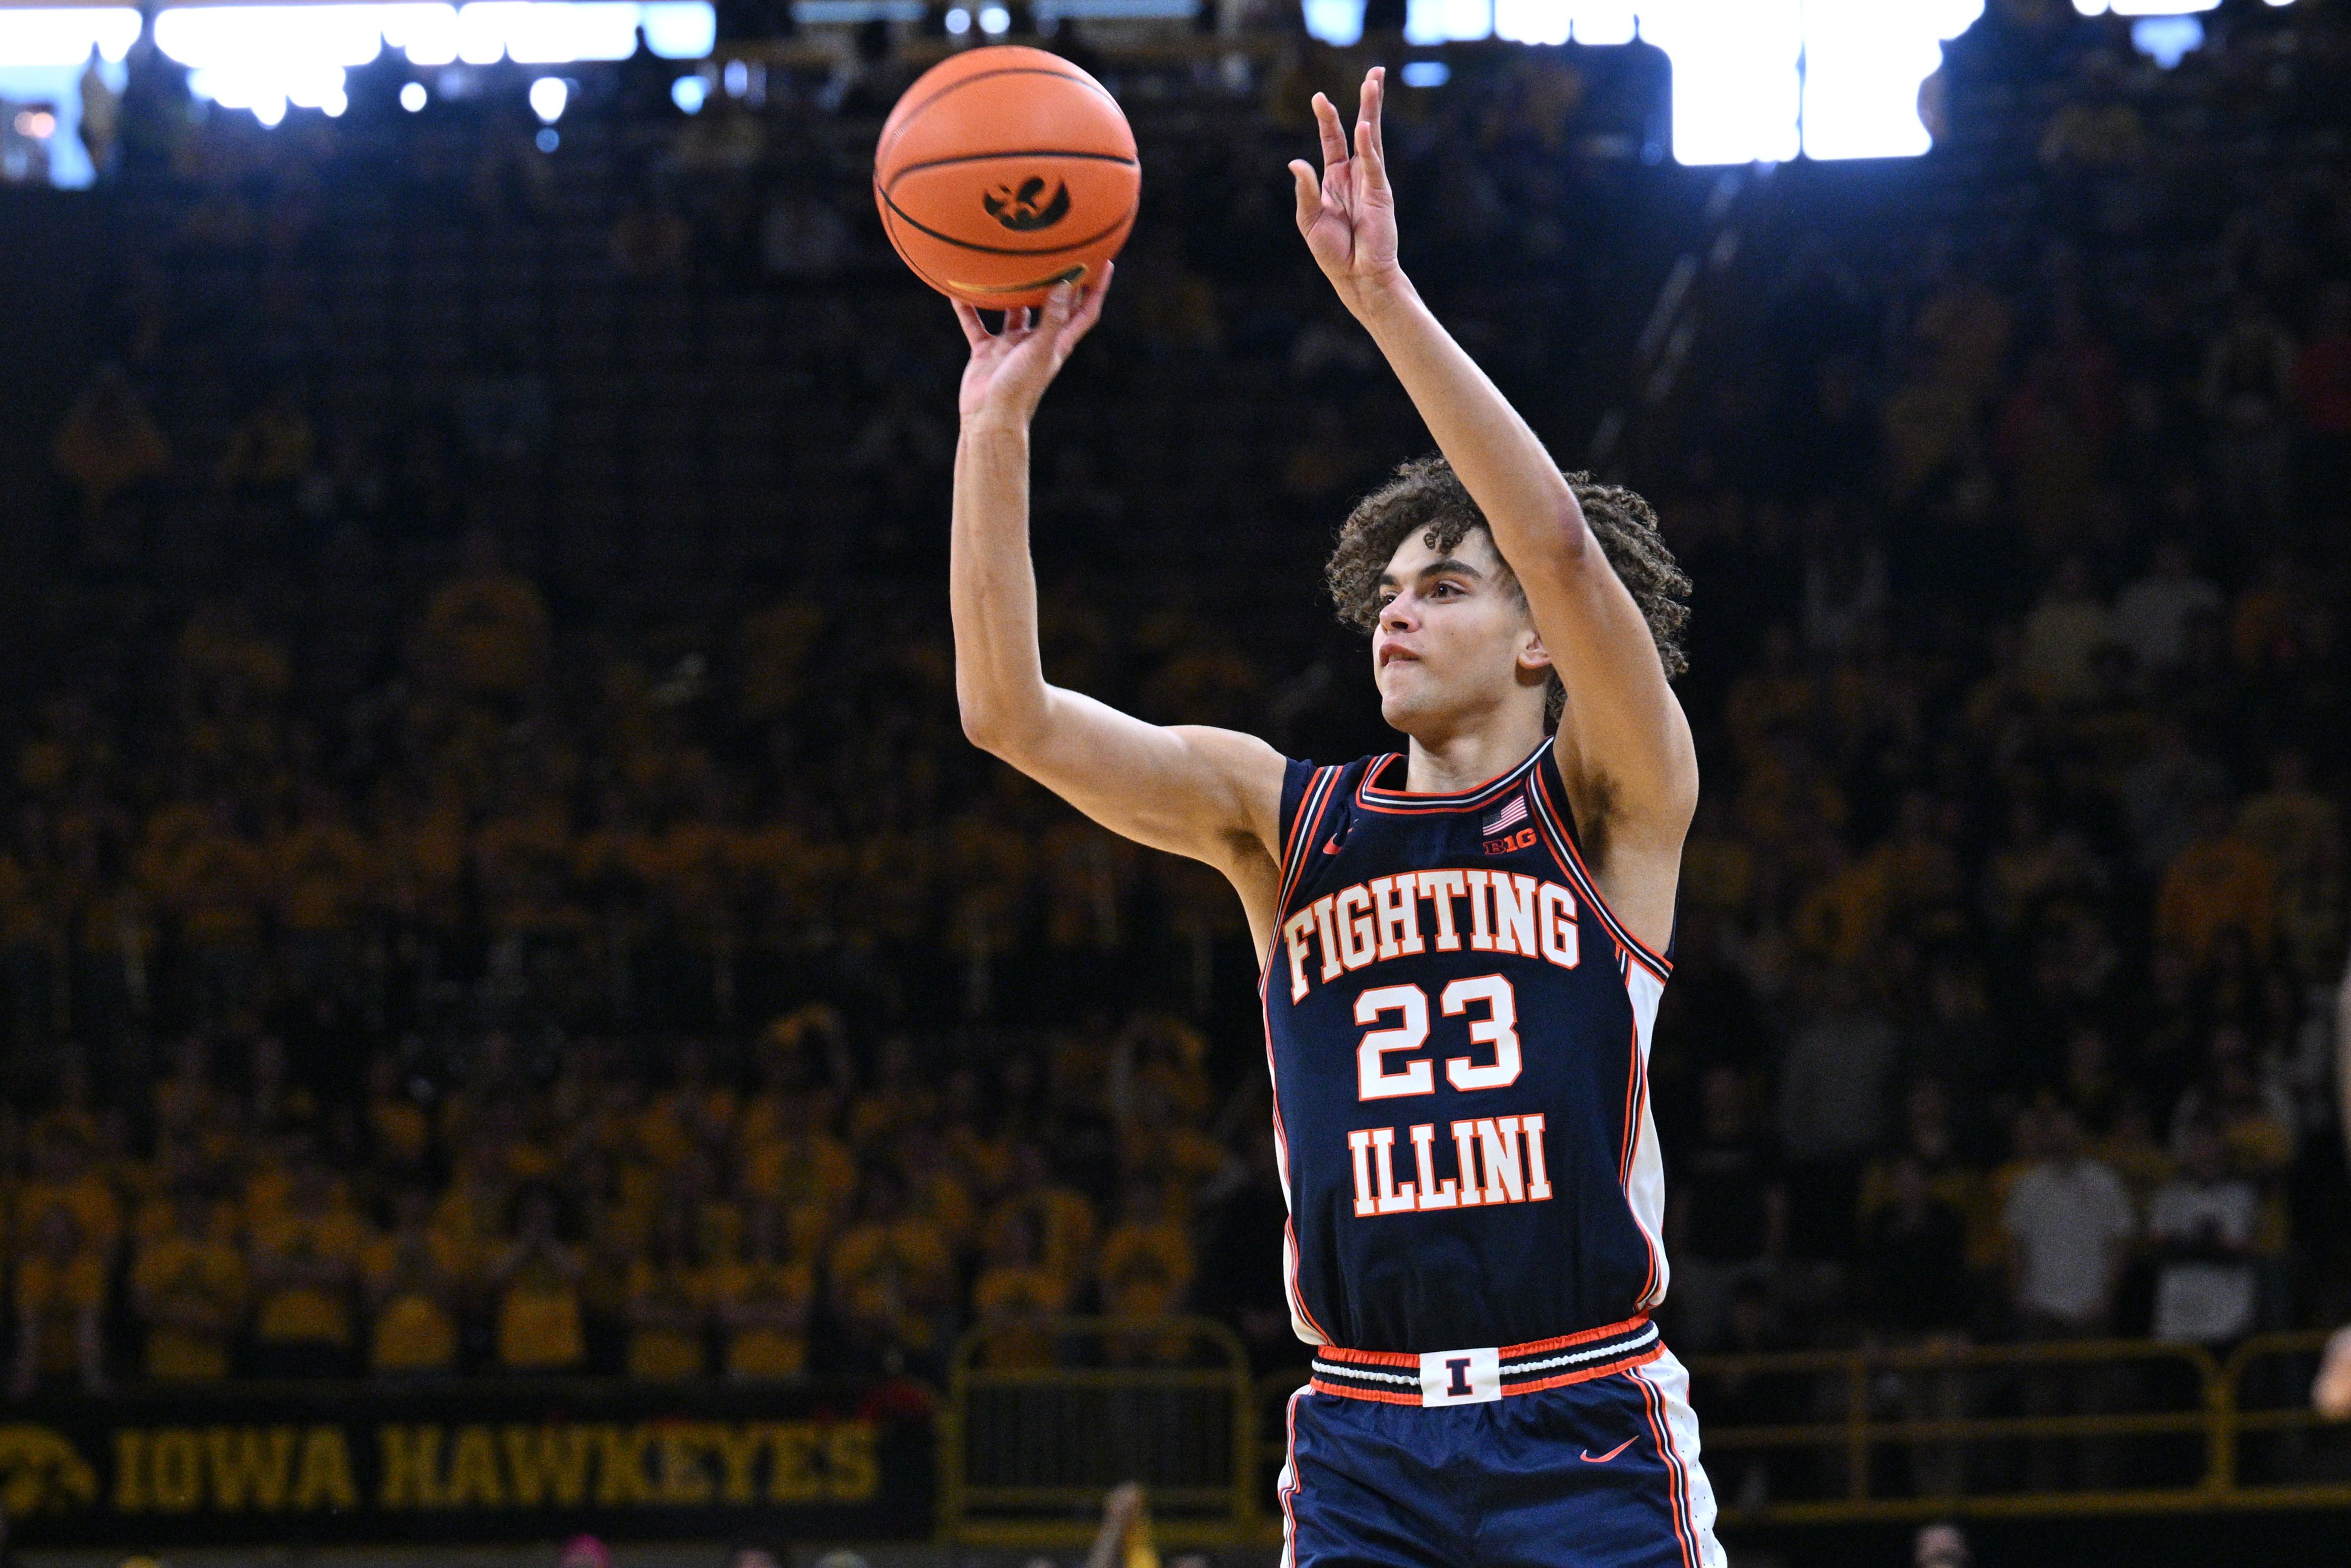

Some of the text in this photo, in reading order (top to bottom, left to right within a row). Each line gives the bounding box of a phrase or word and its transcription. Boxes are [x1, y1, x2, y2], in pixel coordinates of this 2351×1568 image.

[1283, 868, 1579, 1005] FIGHTING
[1353, 973, 1522, 1101] 23
[1348, 1113, 1553, 1217] ILLINI
[1445, 1357, 1473, 1397] I
[115, 1421, 880, 1510] IOWA HAWKEYES
